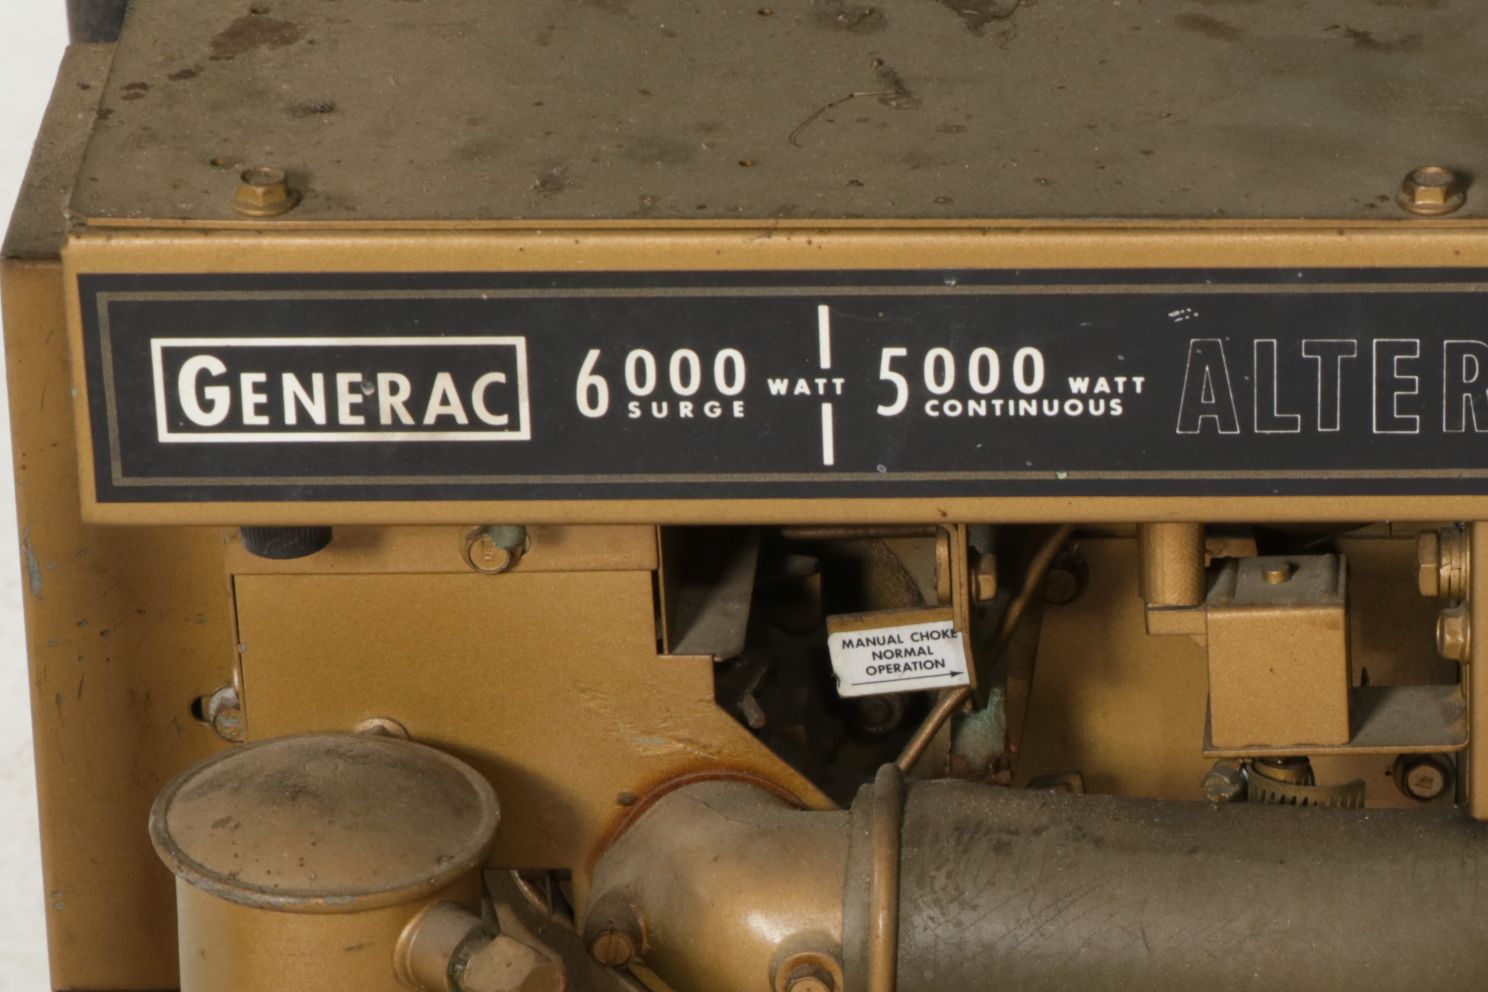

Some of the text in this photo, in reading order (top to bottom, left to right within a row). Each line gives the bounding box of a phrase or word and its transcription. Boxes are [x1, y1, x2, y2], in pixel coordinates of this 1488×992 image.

[177, 354, 510, 427] GENERAC
[575, 347, 846, 419] 6000 WATT
[876, 346, 1146, 417] 5000 WATT
[627, 400, 746, 419] SURGE
[924, 398, 1124, 418] CONTINUOUS
[841, 628, 958, 650] MANUAL CHOKE
[871, 645, 934, 661] NORMAL
[865, 657, 946, 676] OPERATION
